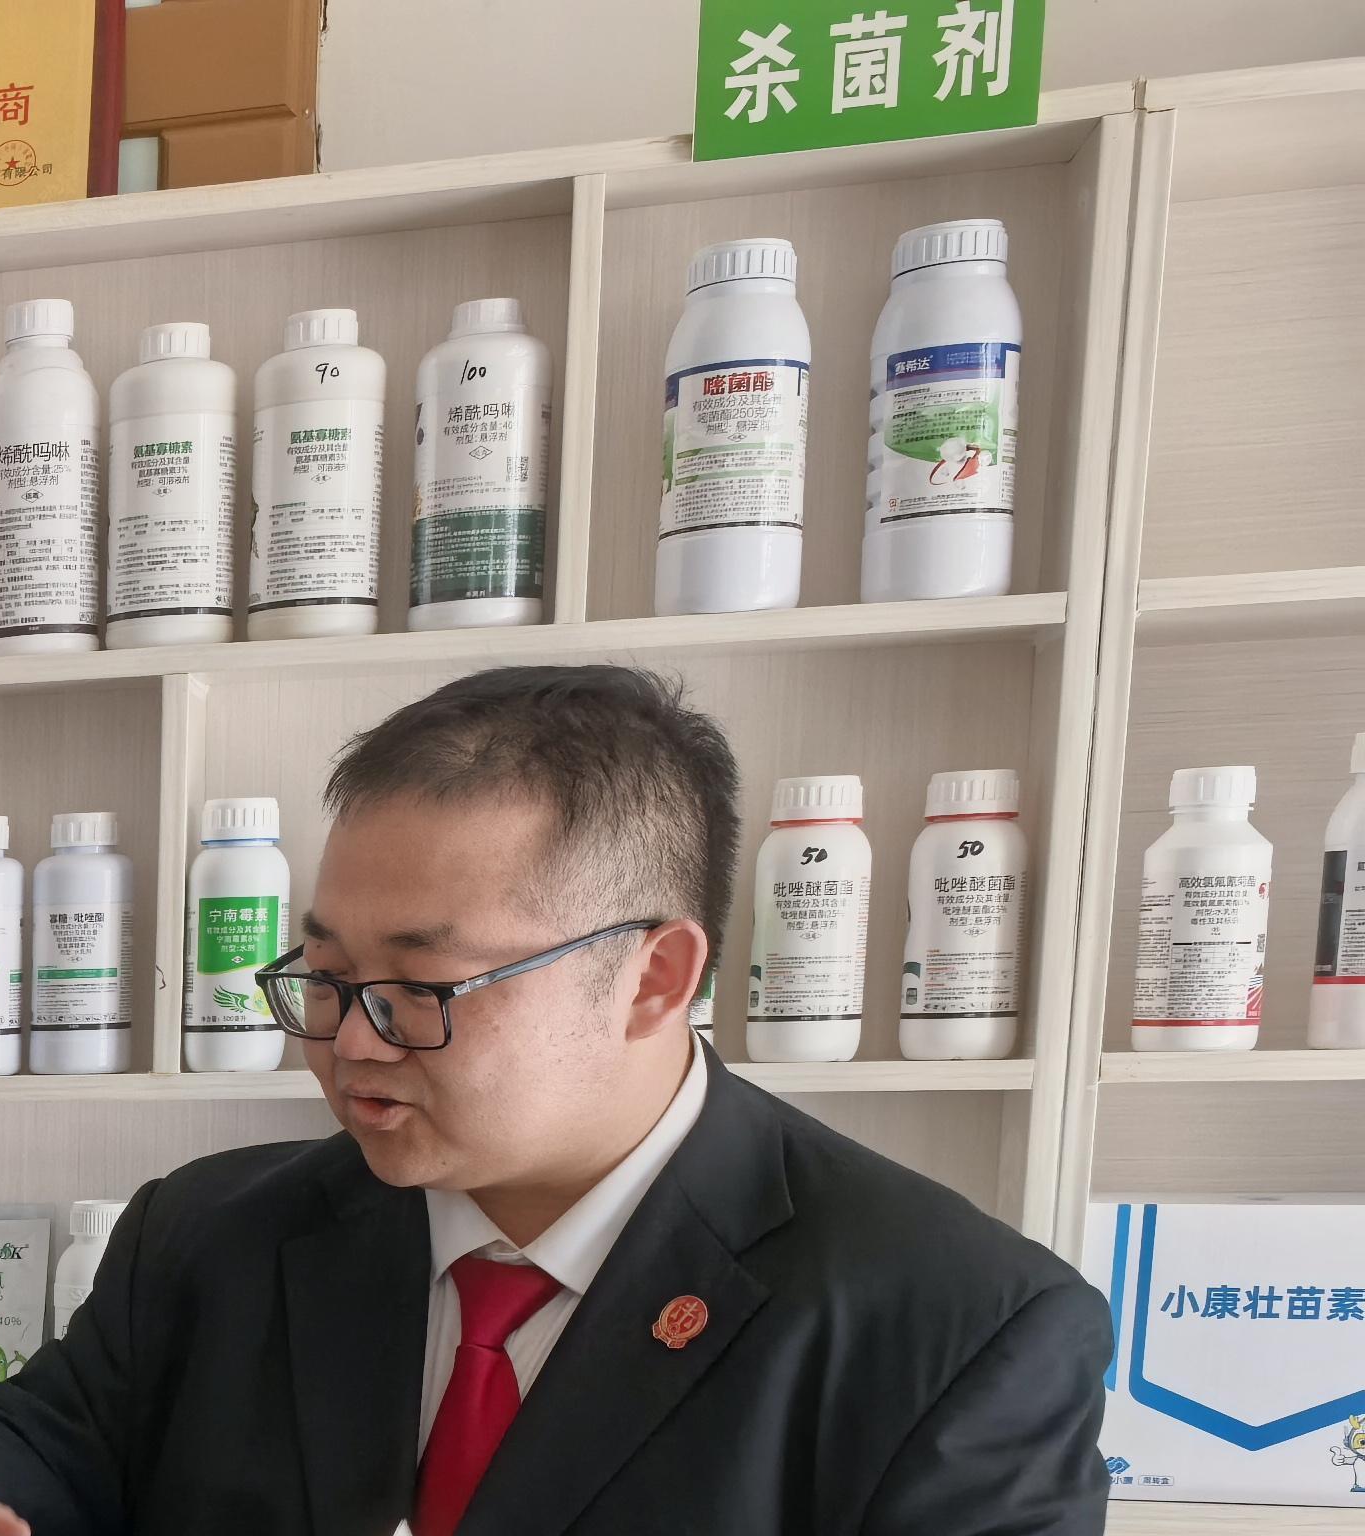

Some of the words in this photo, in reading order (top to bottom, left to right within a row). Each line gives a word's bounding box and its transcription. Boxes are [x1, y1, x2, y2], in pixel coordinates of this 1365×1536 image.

[724, 0, 1014, 123] 杀菌剂
[315, 363, 340, 384] 90
[460, 360, 487, 384] 100
[801, 847, 828, 865] 50
[957, 841, 984, 858] 50
[1160, 1285, 1365, 1321] 小康壮苗素
